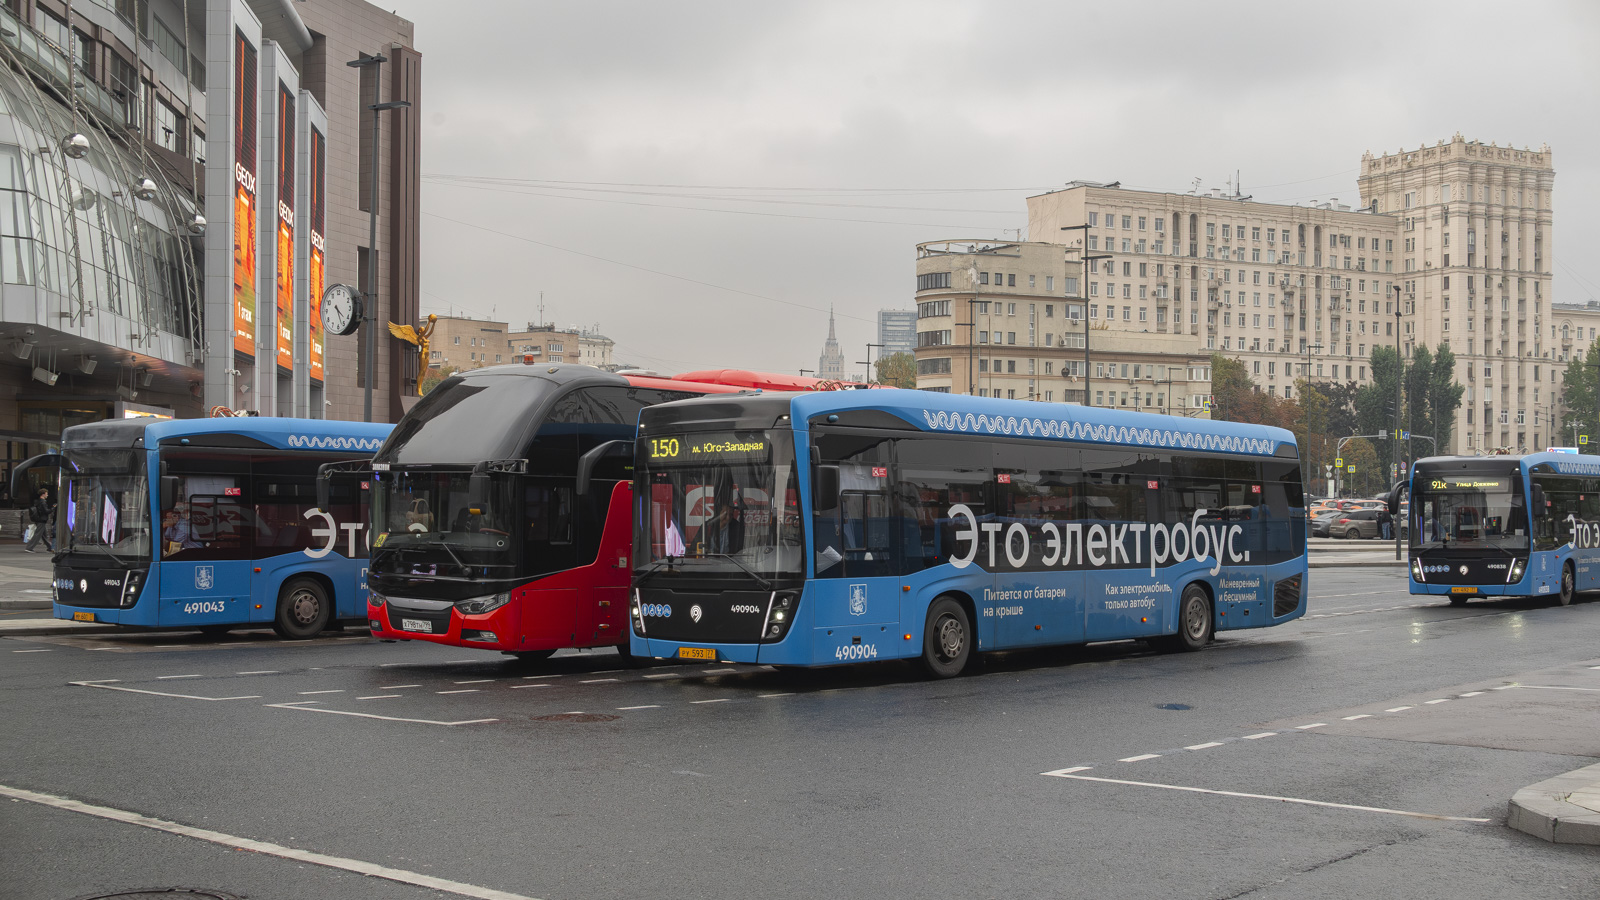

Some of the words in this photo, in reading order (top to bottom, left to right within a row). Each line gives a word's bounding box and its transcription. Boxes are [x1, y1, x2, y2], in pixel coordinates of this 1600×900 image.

[235, 161, 256, 195] GEOX
[278, 199, 294, 228] GEOX
[311, 228, 325, 254] GEOX
[238, 301, 241, 318] 1
[241, 306, 252, 323] этаж
[280, 321, 283, 337] 1
[651, 438, 680, 458] 150
[703, 441, 764, 453] Юго-Западная
[1431, 480, 1448, 489] 91к
[303, 507, 371, 559] Эт
[1567, 513, 1591, 549] Это
[947, 503, 1031, 569] Это
[1040, 508, 1250, 577] электробус.
[1105, 583, 1119, 595] Как
[1119, 581, 1173, 597] электромобиль,
[1218, 578, 1261, 590] Маневренный
[983, 588, 1022, 601] Питается
[1023, 590, 1033, 599] от
[1034, 586, 1066, 600] батареи
[1218, 594, 1224, 602] и
[1224, 590, 1258, 603] бесшумный
[184, 601, 225, 614] 491043
[731, 604, 760, 614] 490904
[1105, 600, 1128, 610] только
[1129, 596, 1156, 610] автобус
[983, 607, 994, 617] на
[995, 605, 1024, 619] крыше
[691, 649, 704, 658] 593
[835, 644, 878, 661] 490904
